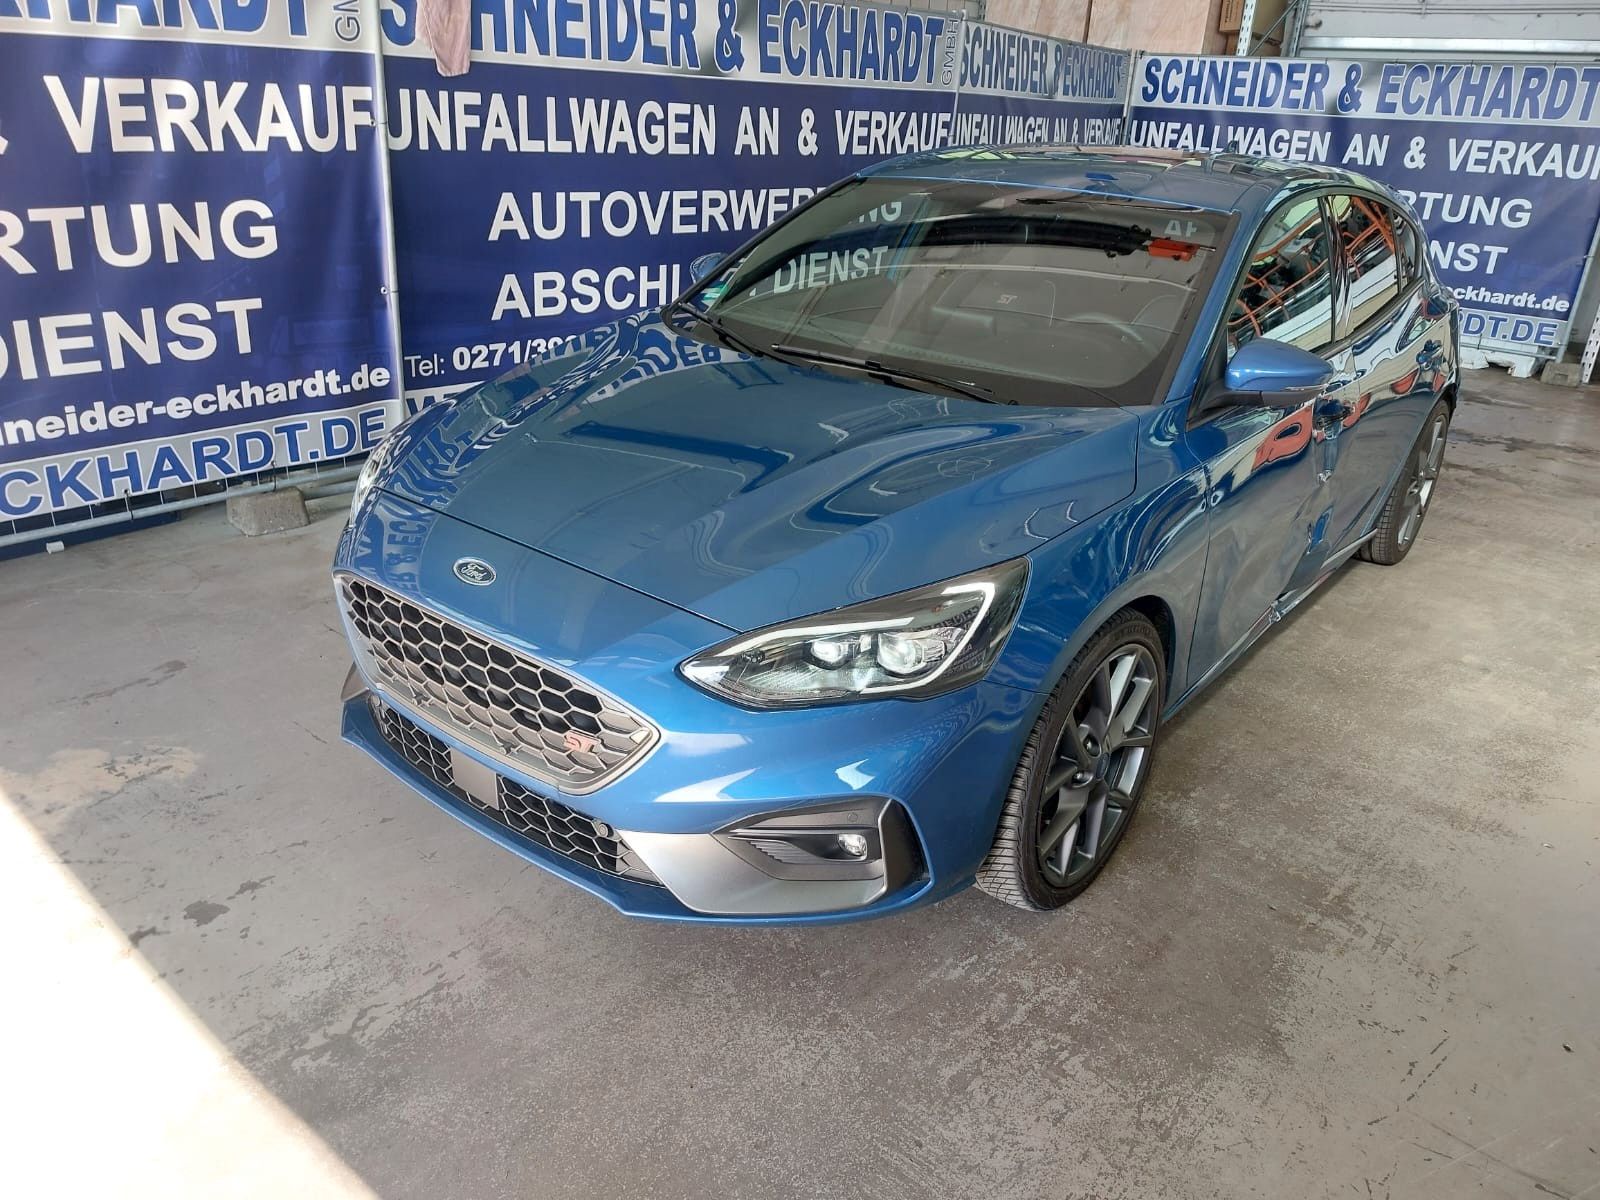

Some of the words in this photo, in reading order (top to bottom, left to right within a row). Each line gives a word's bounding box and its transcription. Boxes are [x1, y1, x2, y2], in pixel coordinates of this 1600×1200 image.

[715, 0, 744, 73] &
[757, 0, 945, 84] ECKHARDT
[941, 17, 960, 86] GMBH
[960, 21, 1048, 94] SCHNEIDER
[43, 75, 373, 154] VERKAUF
[388, 88, 715, 156] UNFALLWAGEN
[735, 106, 779, 155] AN
[798, 108, 818, 156] &
[835, 109, 951, 155] VERKAUF
[1142, 58, 1330, 111] SCHNEIDER
[1338, 63, 1363, 113] &
[1376, 64, 1600, 121] ECKHARDT
[1054, 118, 1067, 144] AN
[1130, 120, 1331, 162] UNFALLWAGEN
[1342, 134, 1390, 166] AN
[1403, 136, 1427, 170] &
[404, 353, 445, 378] Tel:
